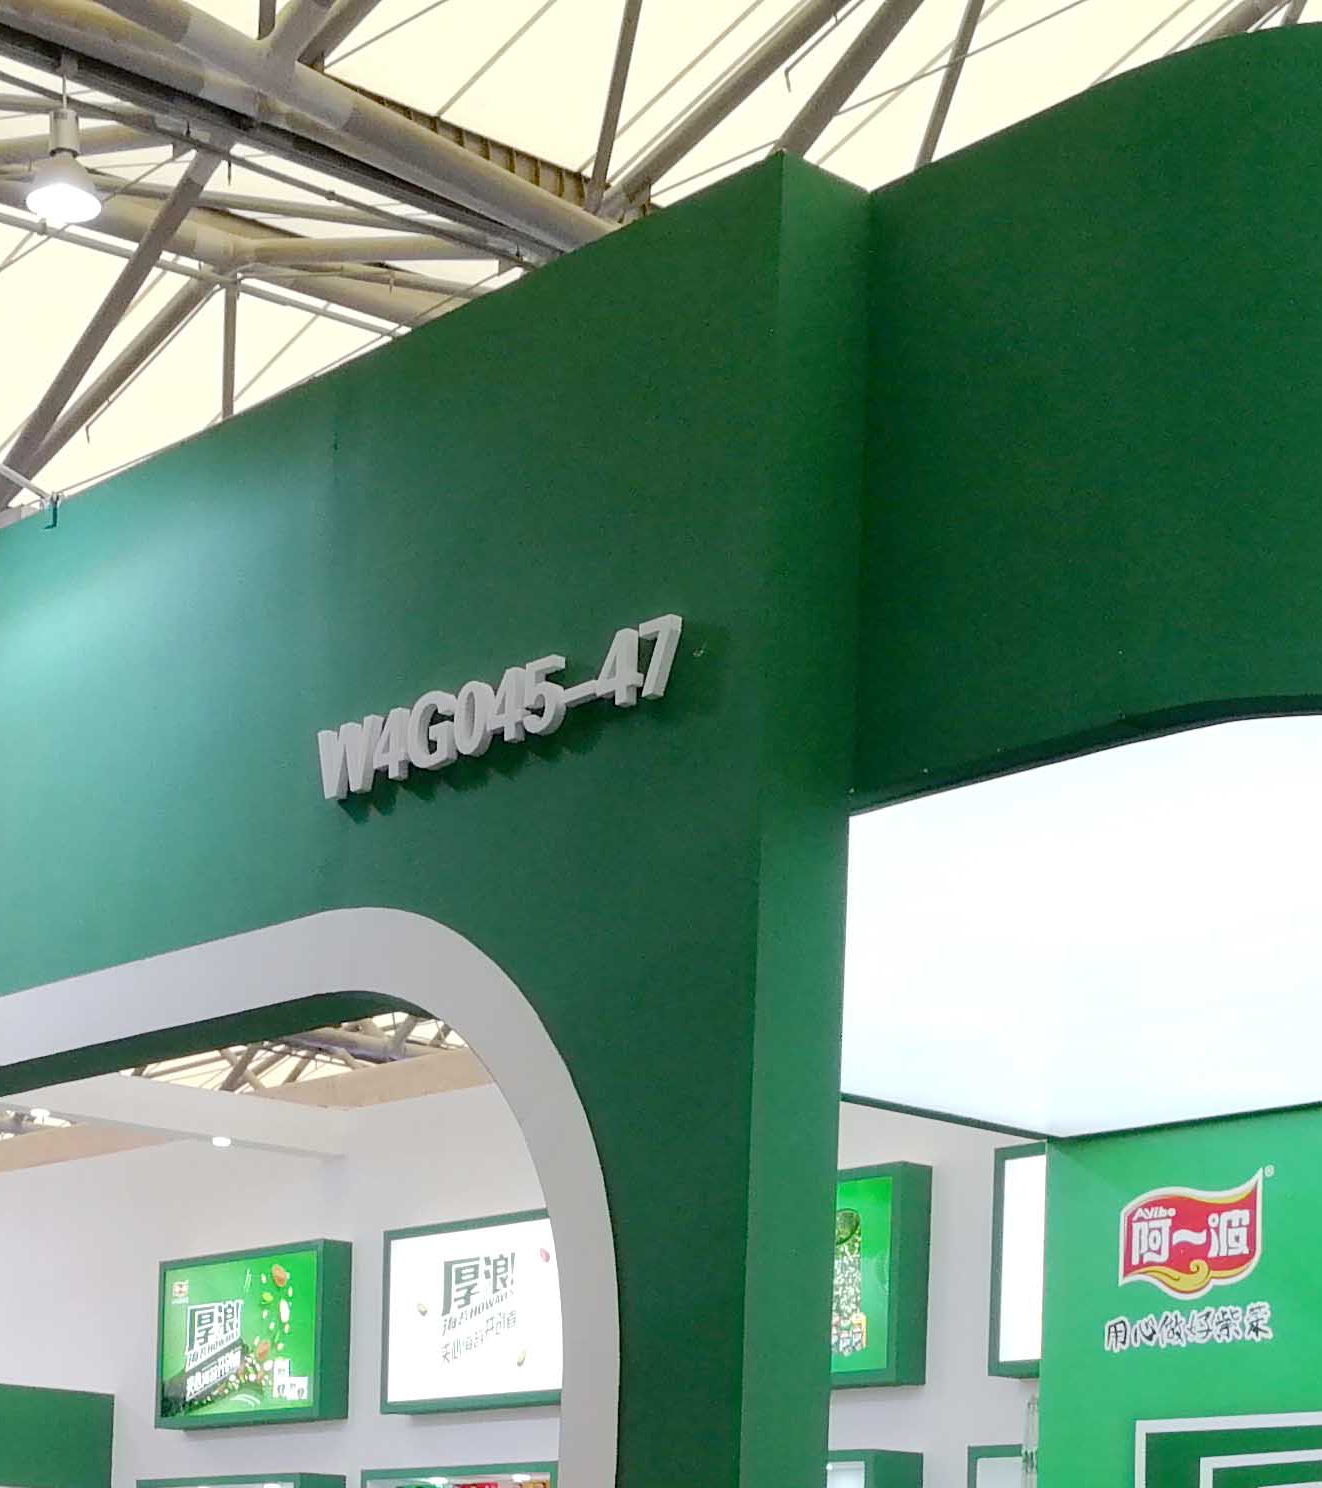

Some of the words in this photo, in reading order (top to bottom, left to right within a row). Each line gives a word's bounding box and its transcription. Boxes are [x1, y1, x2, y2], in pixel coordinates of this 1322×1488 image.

[317, 613, 683, 800] W4G045-47
[1131, 1208, 1251, 1266] 阿一波
